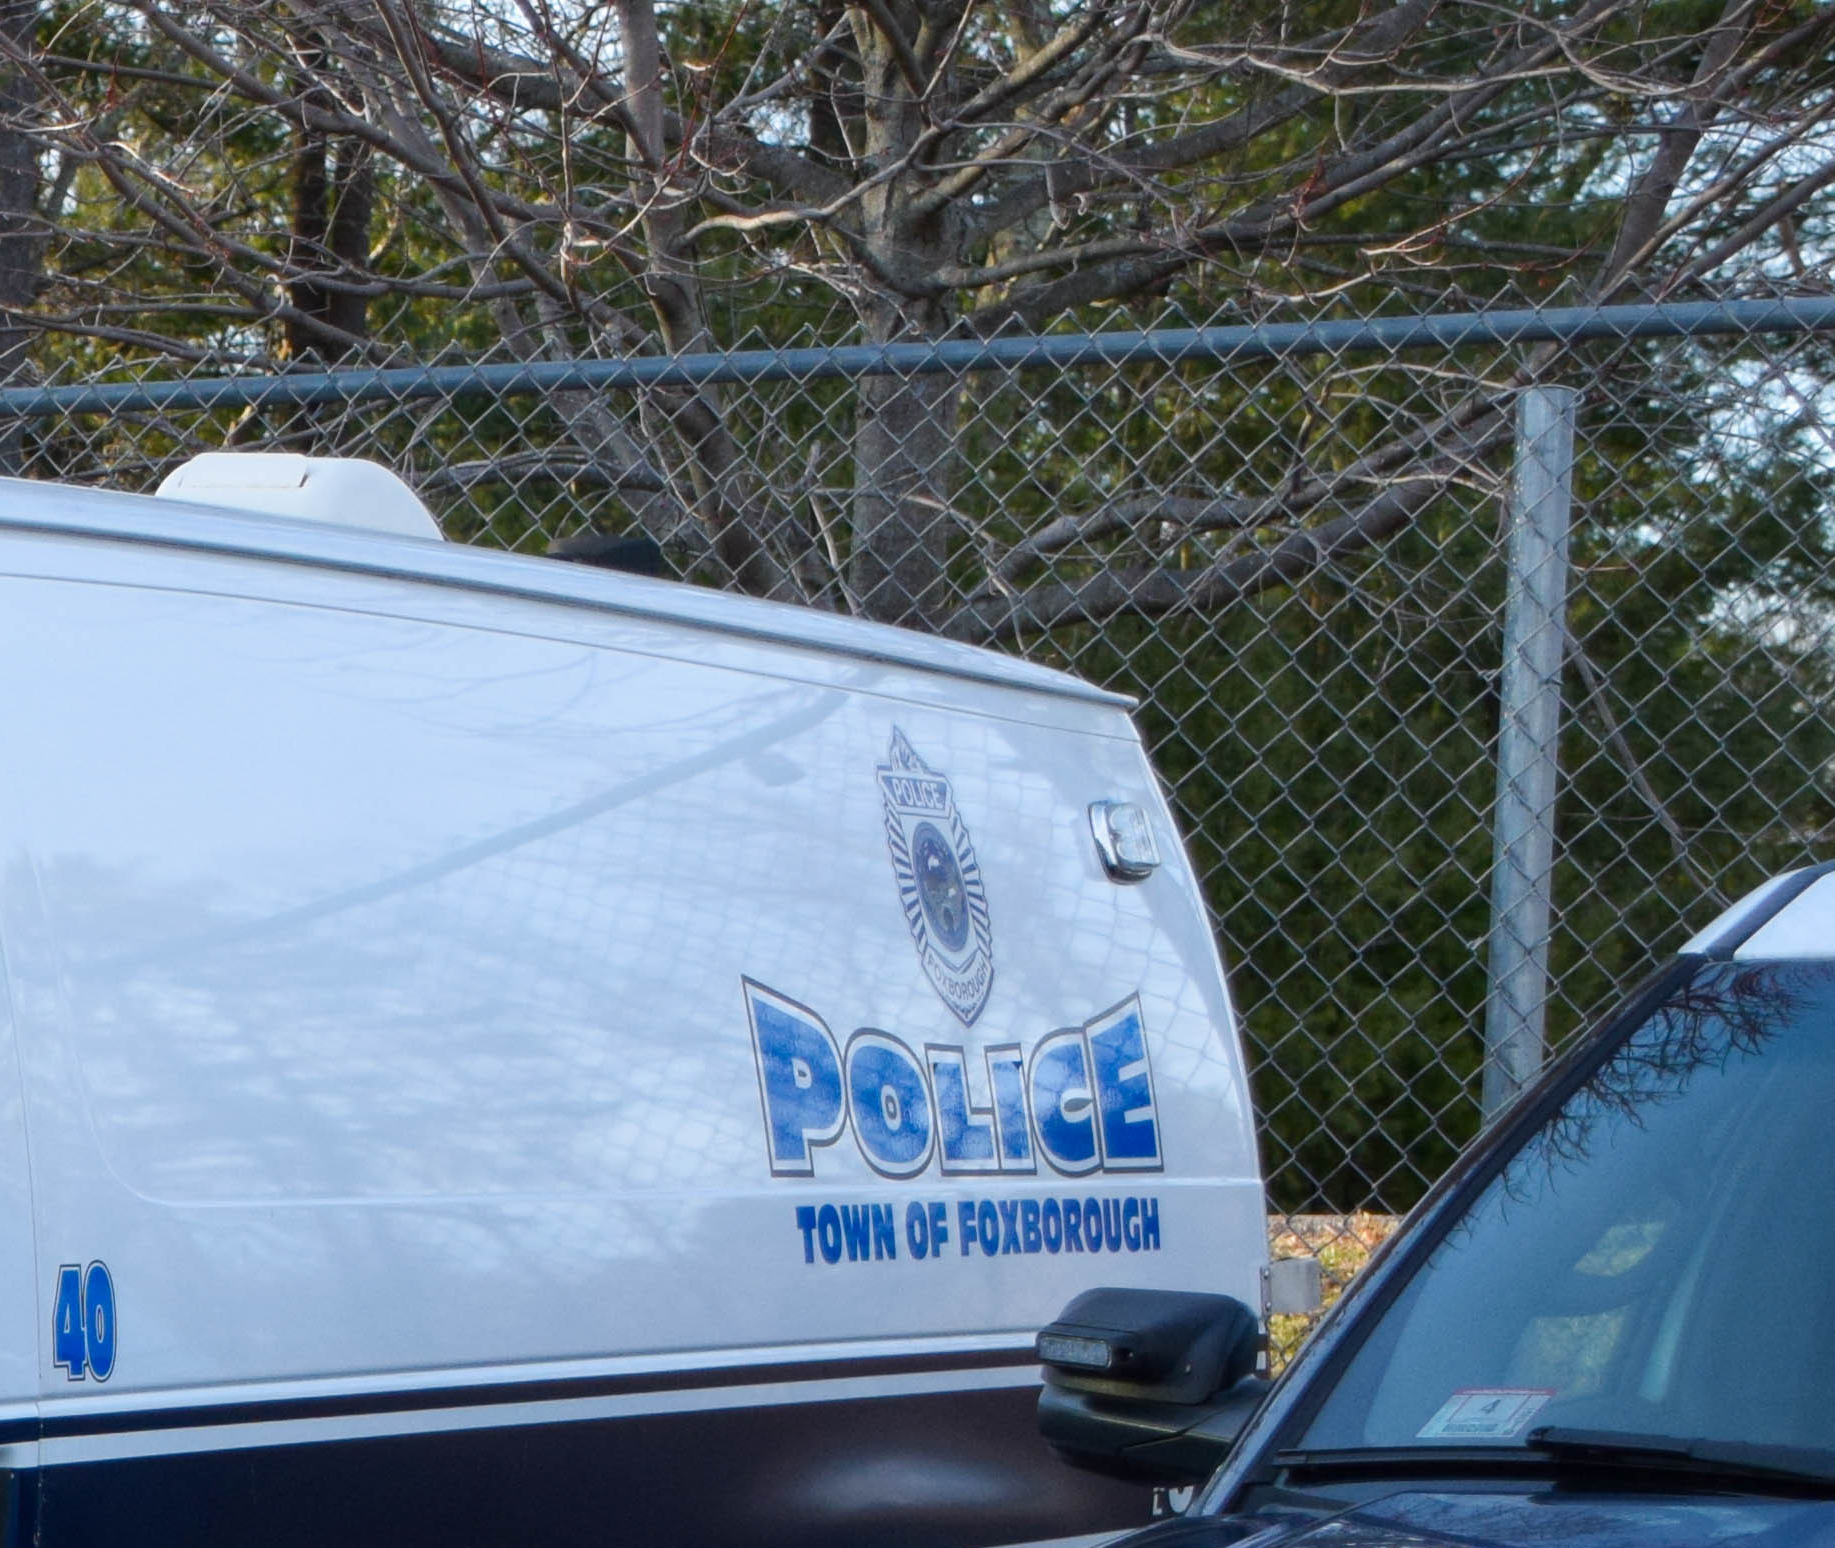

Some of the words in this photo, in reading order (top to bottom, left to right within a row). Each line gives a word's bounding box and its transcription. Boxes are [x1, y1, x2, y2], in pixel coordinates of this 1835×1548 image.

[892, 778, 946, 809] POLICE
[741, 974, 1164, 1179] POLICE
[796, 1202, 896, 1264] TOWN
[905, 1201, 949, 1259] OF
[959, 1197, 1161, 1256] FOXBOROUGH
[52, 1260, 117, 1382] 40
